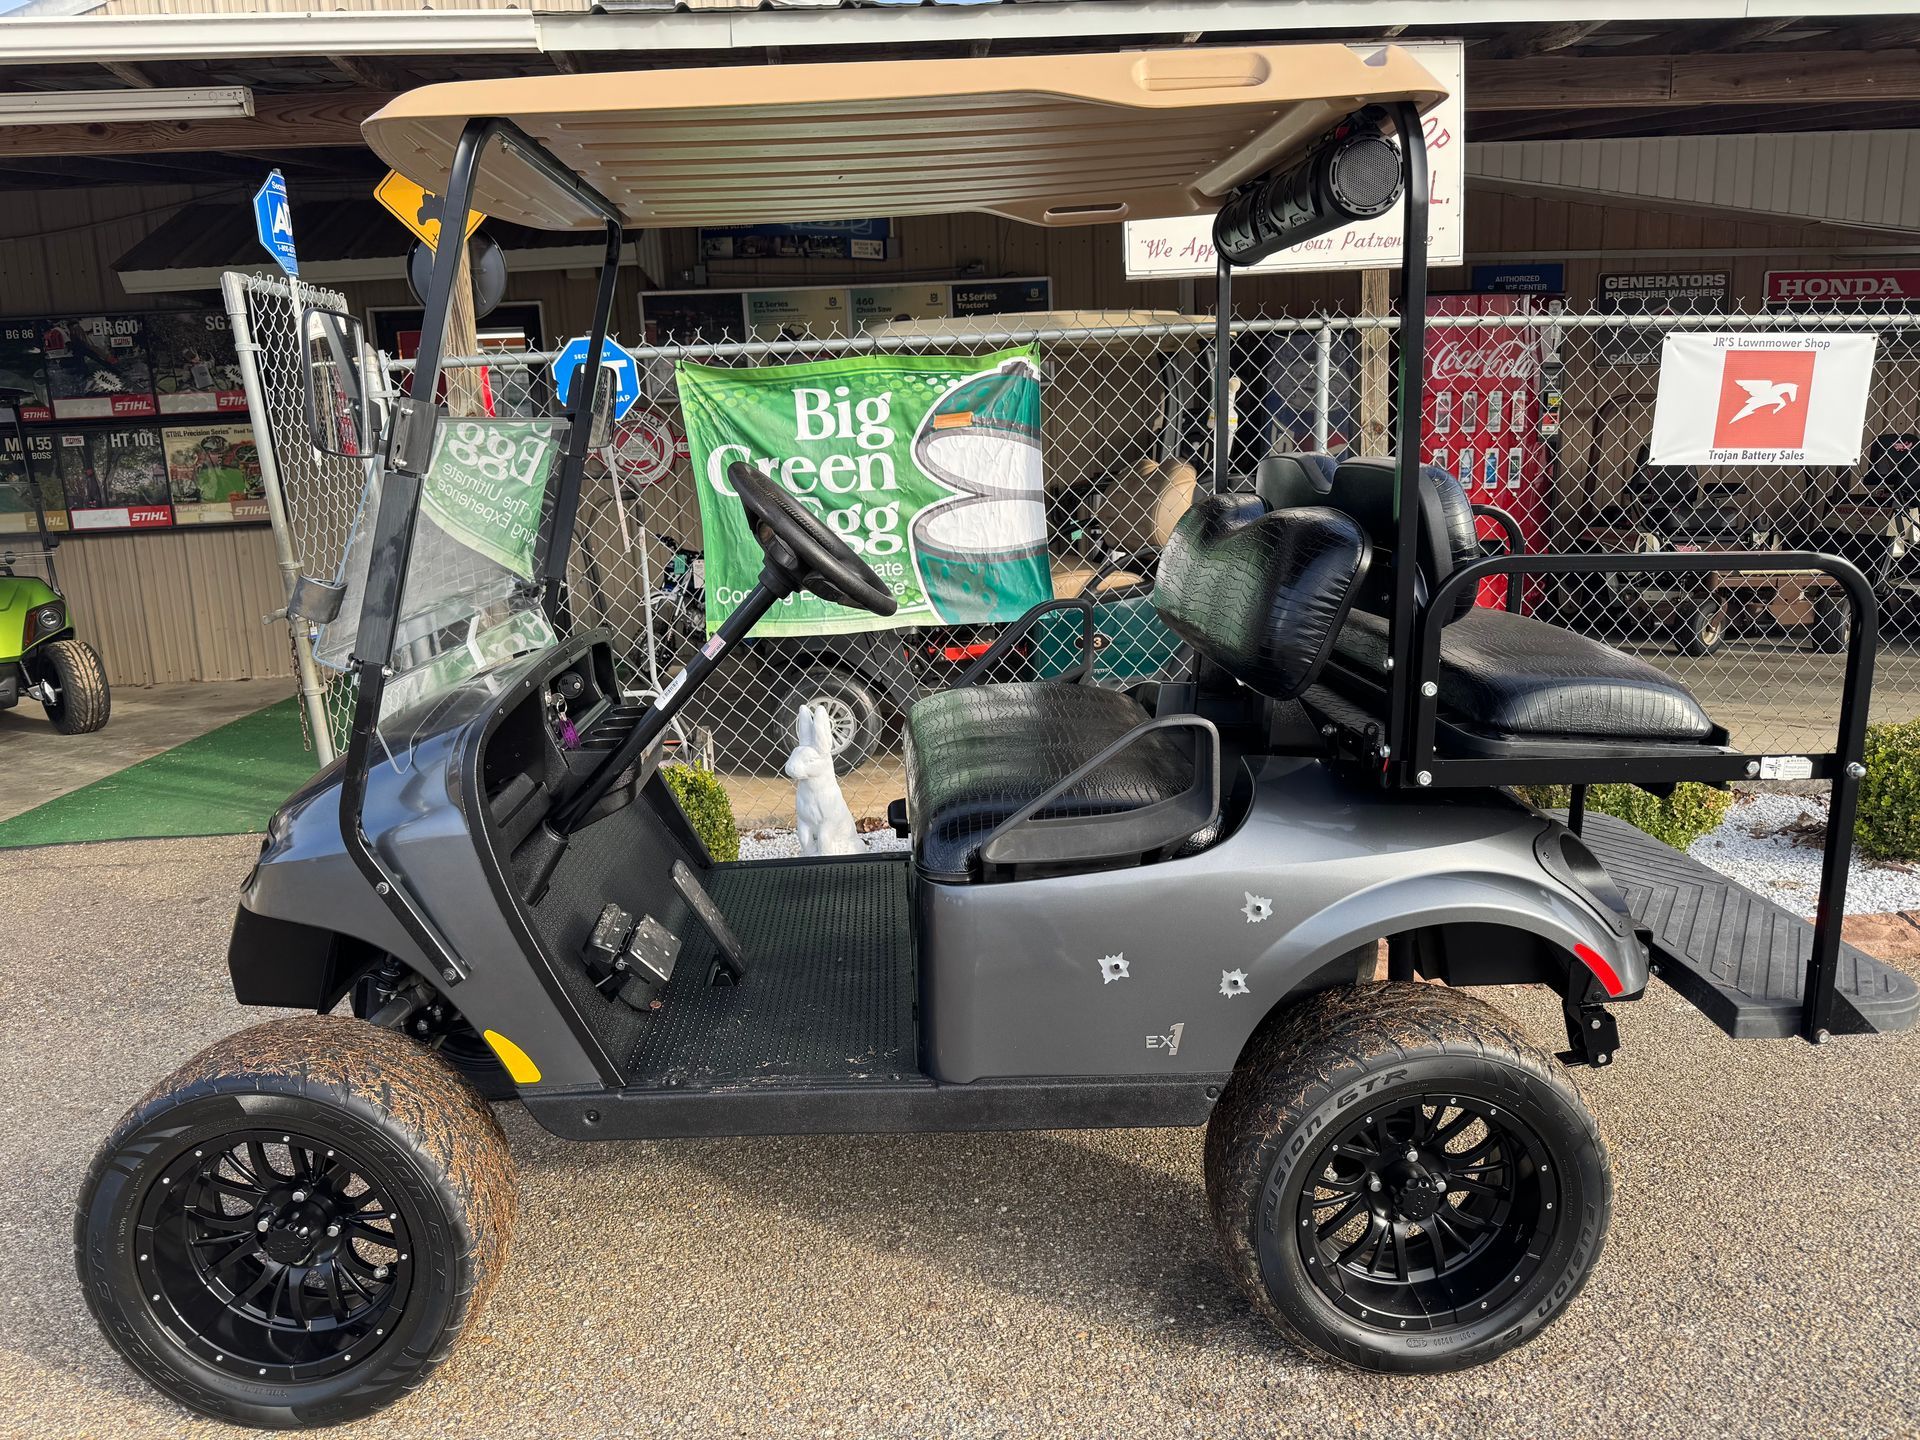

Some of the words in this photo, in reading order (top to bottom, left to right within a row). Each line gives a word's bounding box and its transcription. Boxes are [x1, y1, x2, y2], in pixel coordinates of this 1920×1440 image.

[1495, 274, 1541, 283] AUTHORIZED
[1604, 273, 1726, 290] GENERATORS
[1518, 283, 1548, 291] CENTER
[1776, 277, 1904, 297] HONDA
[956, 293, 968, 301] LS
[968, 292, 997, 301] Series
[1605, 289, 1666, 300] PRESSURE
[1667, 288, 1725, 299] WASHERS
[957, 301, 989, 309] Tractors
[93, 321, 113, 337] BR
[114, 319, 139, 335] 600
[205, 315, 226, 331] SG
[5, 329, 20, 340] BG
[21, 328, 34, 339] 86
[1713, 336, 1735, 347] JR'S
[1738, 337, 1802, 348] Lawnmower
[1804, 337, 1831, 350] Shop
[1609, 352, 1649, 365] SALES
[113, 399, 150, 412] STIHL
[219, 396, 248, 407] STIH
[22, 411, 50, 420] STIHL
[790, 385, 896, 451] Big
[183, 429, 211, 438] Precision
[210, 428, 230, 436] Series
[35, 436, 53, 451] 55
[110, 432, 130, 448] HT
[132, 432, 154, 447] 101
[31, 451, 52, 460] BOSS
[1709, 449, 1738, 463] Trojan
[1741, 449, 1777, 463] Battery
[1779, 449, 1805, 460] Sales
[131, 511, 169, 522] STIHL
[235, 505, 270, 517] STIHL
[28, 516, 65, 527] SHL
